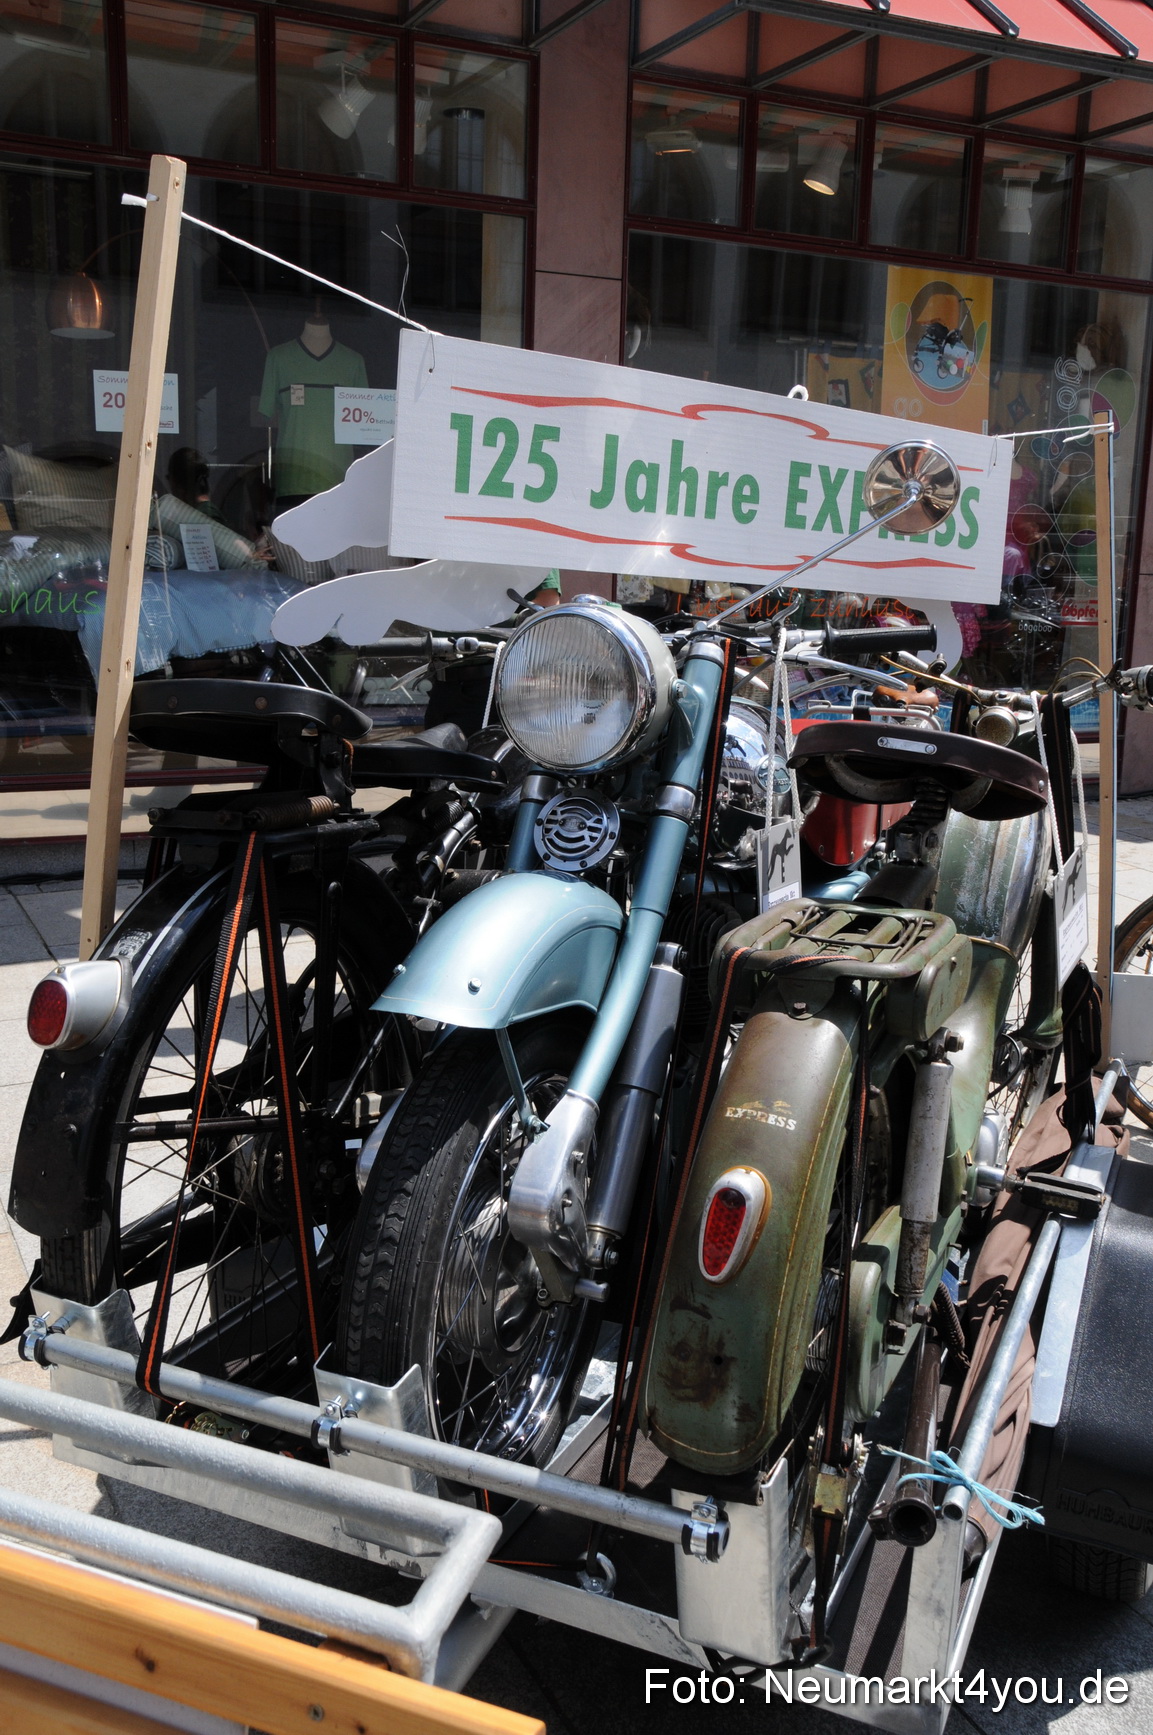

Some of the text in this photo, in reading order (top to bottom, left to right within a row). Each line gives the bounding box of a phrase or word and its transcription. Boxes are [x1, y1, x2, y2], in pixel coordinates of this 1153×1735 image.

[102, 391, 126, 409] 20
[338, 391, 375, 401] Sommer
[341, 407, 376, 424] 20%
[450, 412, 980, 550] 125 Jahre EXPS
[725, 1106, 798, 1131] EXPRESS
